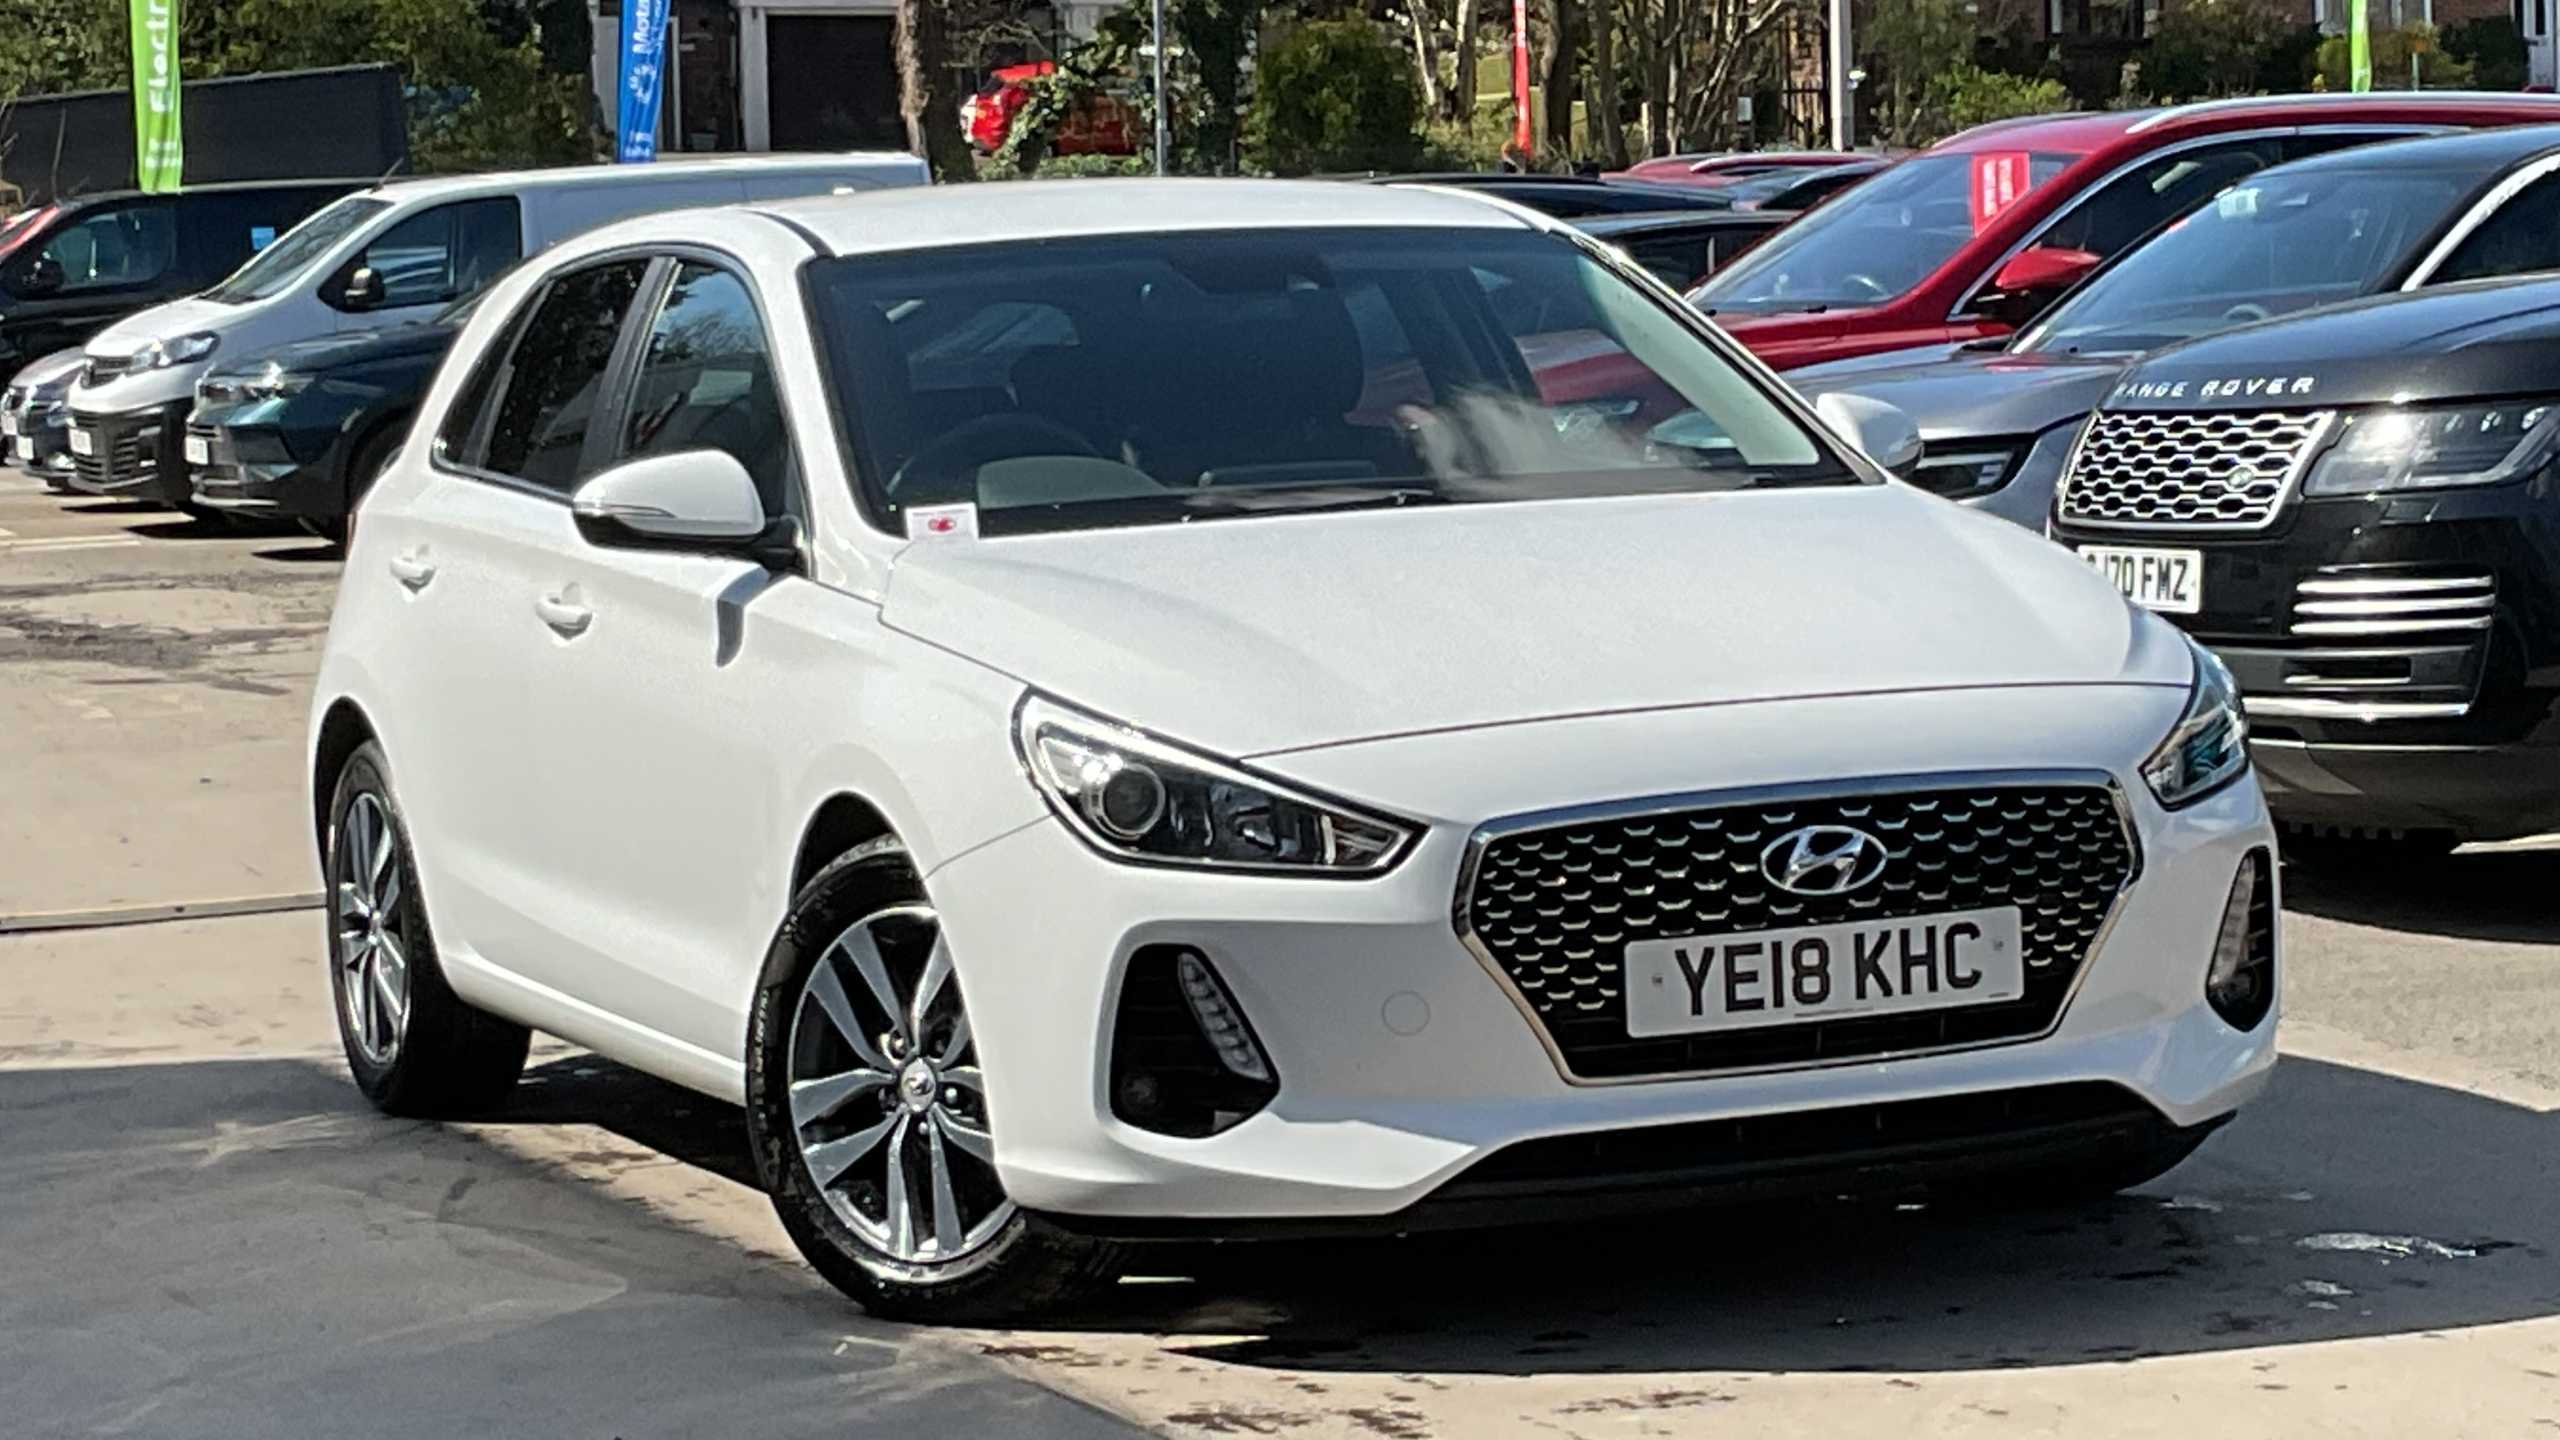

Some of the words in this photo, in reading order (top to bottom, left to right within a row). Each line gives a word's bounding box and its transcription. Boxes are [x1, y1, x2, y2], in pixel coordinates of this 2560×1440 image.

[2113, 382, 2189, 398] RANGE
[2201, 377, 2315, 397] ROVER
[2086, 553, 2135, 598] 70
[2141, 556, 2188, 601] FMZ
[1675, 937, 1831, 1016] YE18
[1853, 921, 1983, 1001] KHC
